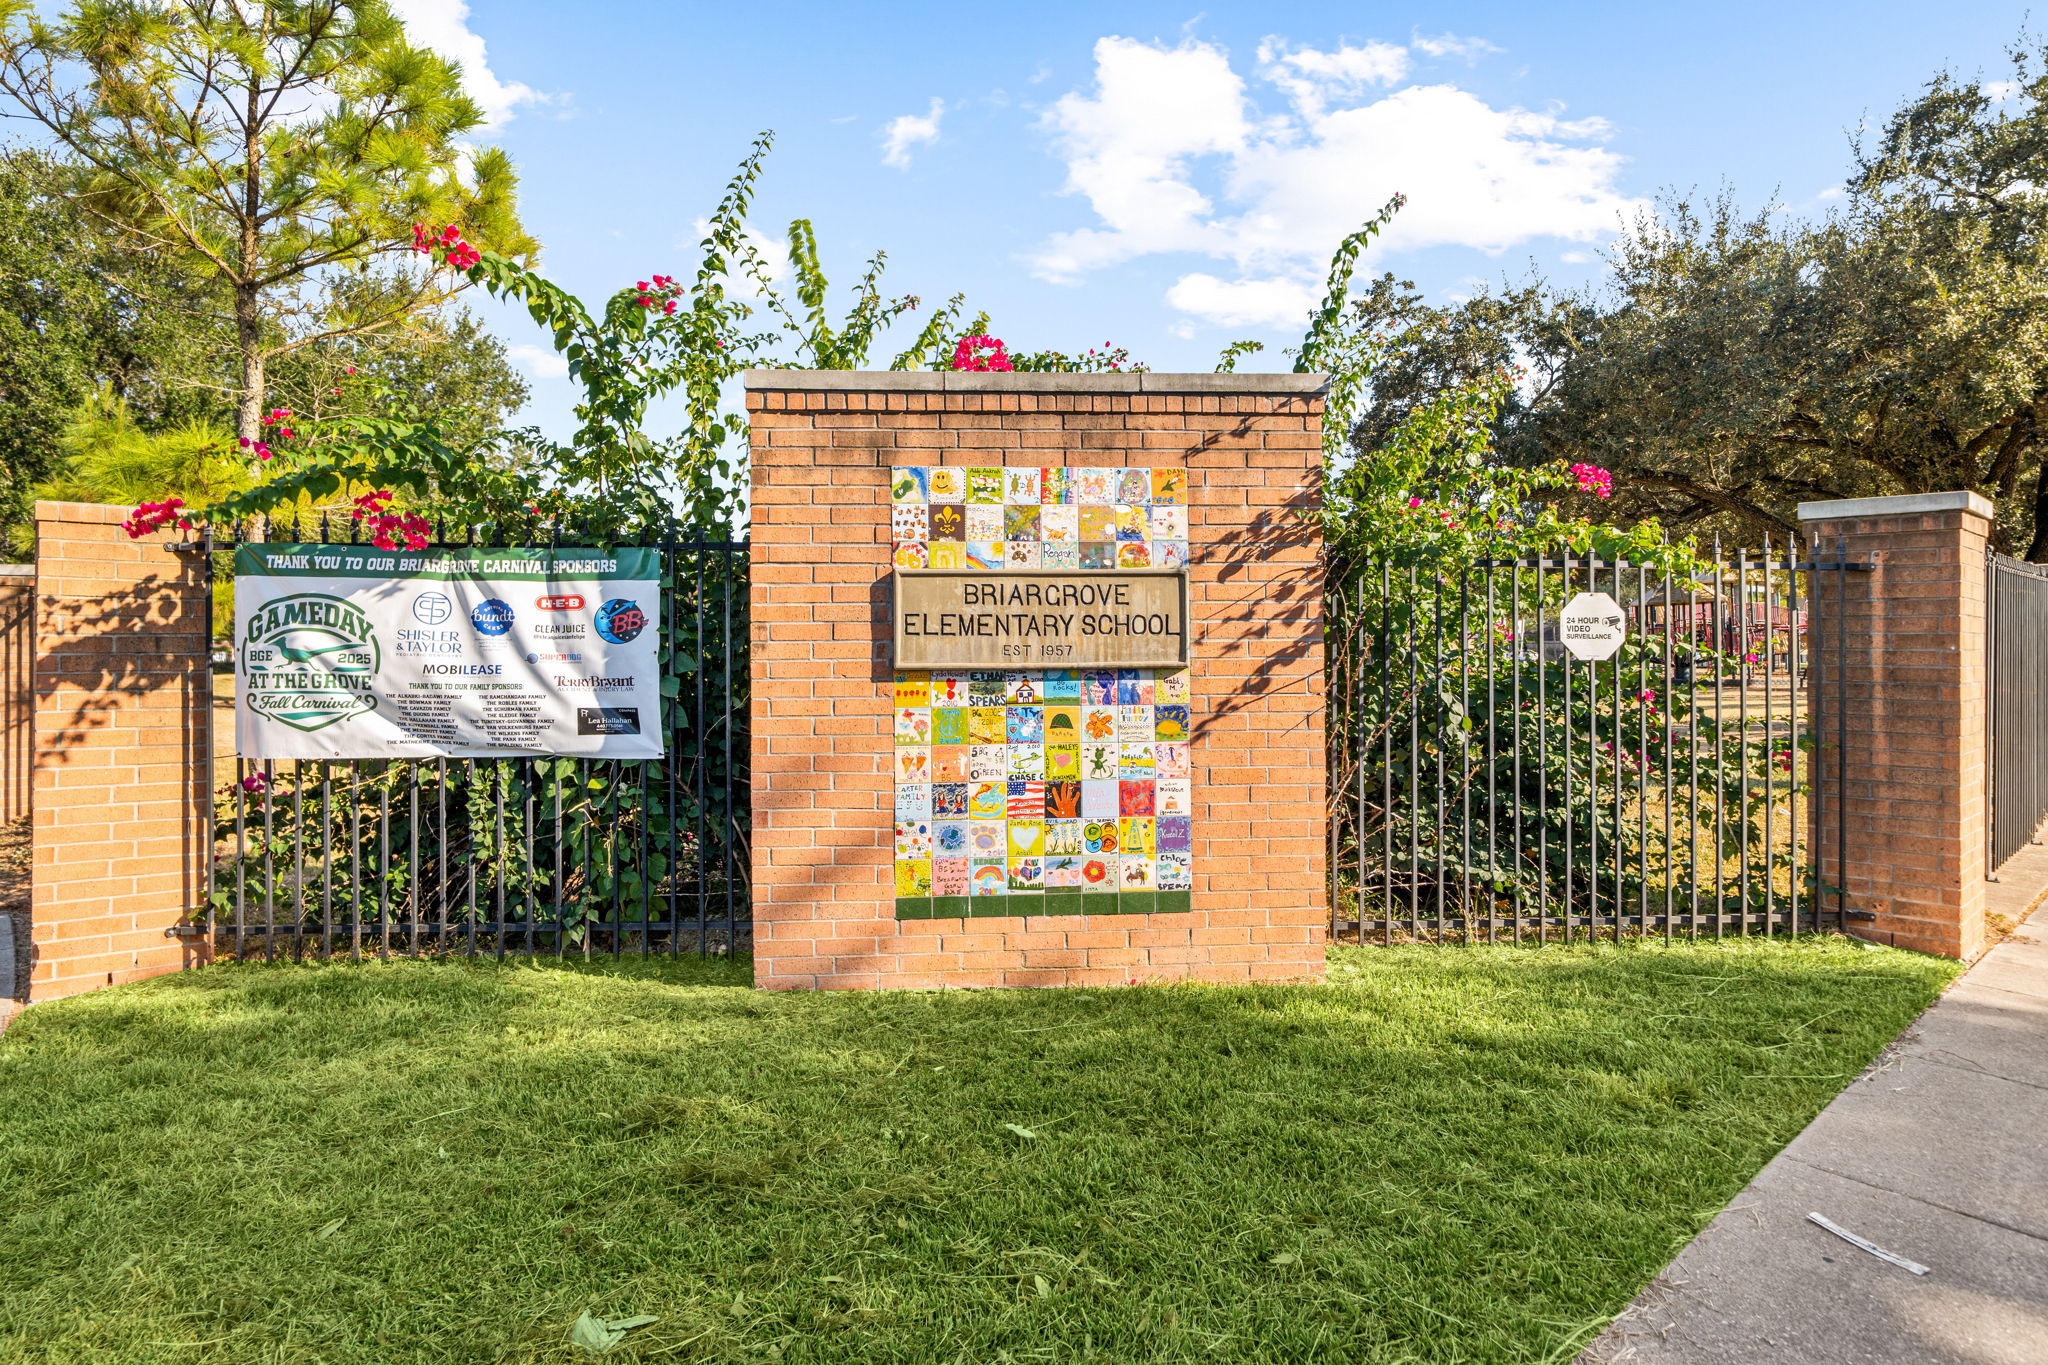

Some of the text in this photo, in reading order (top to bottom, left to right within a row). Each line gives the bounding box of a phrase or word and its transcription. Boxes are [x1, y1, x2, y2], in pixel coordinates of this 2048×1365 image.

[1042, 543, 1075, 562] Reagan
[266, 554, 617, 575] THANK YOU TO OUR BRIARGROVE CARNIVAL SPONSORS
[964, 583, 1130, 606] BRIARGROVE
[472, 608, 516, 622] bundt
[248, 601, 374, 644] GAMEDAY
[535, 624, 586, 633] CLEAN JUICE
[612, 610, 643, 634] BB
[904, 613, 1180, 637] ELEMENTARY SCHOOL
[396, 629, 459, 642] SHISLER
[396, 642, 404, 651] &
[406, 642, 462, 654] TAYLOR
[1003, 644, 1073, 656] EST 1957
[250, 650, 272, 662] BGE
[338, 653, 371, 664] 2025
[422, 664, 502, 675] MOBILEASE
[248, 672, 372, 691] AT THE GROVE
[409, 682, 429, 690] THANK
[258, 694, 362, 709] Fall Carnival
[968, 694, 1006, 707] SPEARS
[896, 784, 923, 793] CARTER
